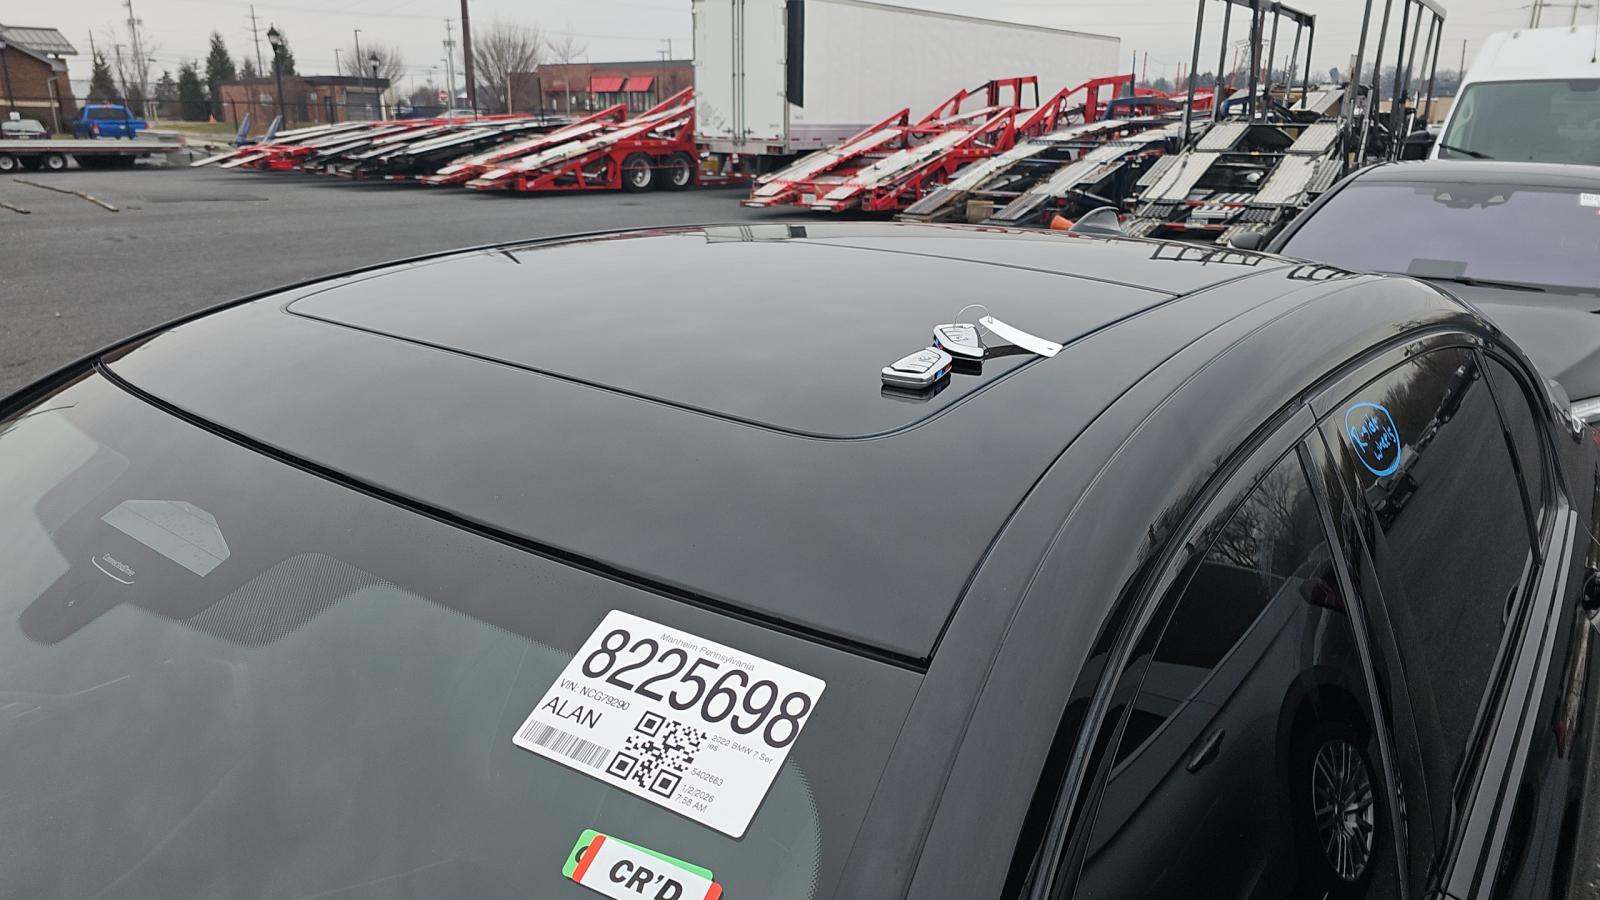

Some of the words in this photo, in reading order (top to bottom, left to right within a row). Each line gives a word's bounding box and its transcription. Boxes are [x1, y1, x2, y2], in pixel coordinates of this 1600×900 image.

[660, 633, 698, 651] Manheim
[699, 646, 755, 672] Pennsylvania
[560, 678, 578, 692] VIN:
[579, 685, 630, 711] NCG79290
[582, 629, 811, 748] 8225698
[541, 696, 603, 729] ALAN
[707, 743, 719, 752] ies
[711, 735, 731, 747] 2022
[731, 742, 752, 755] BMW
[752, 750, 760, 758] 7
[759, 753, 773, 764] Ser
[691, 768, 724, 787] 5402663
[675, 794, 692, 806] 7:58
[692, 801, 708, 813] AM
[681, 784, 715, 803] 1/2/2026
